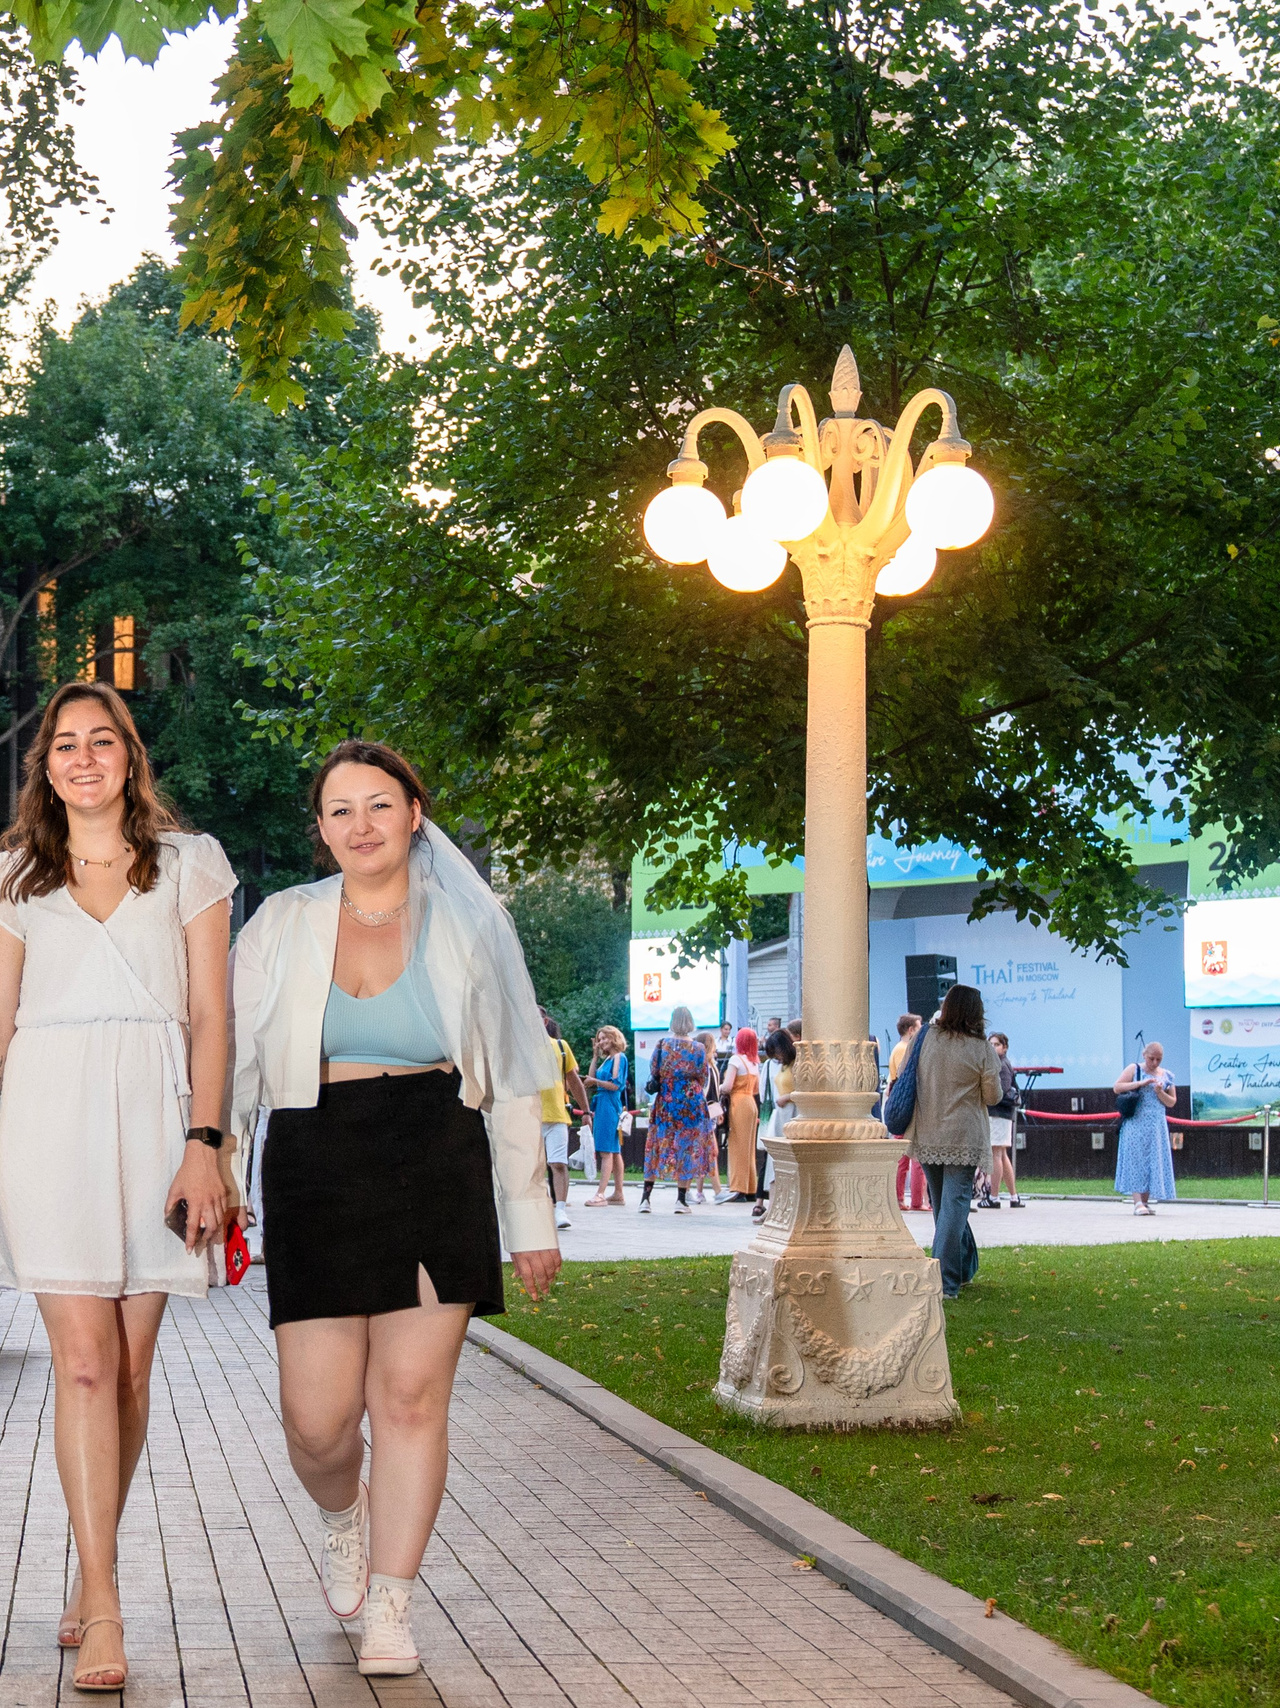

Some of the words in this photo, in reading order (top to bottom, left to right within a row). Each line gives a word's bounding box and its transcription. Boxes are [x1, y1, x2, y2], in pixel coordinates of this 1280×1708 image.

[1017, 962, 1060, 973] FESTIVAL
[1027, 973, 1060, 982] MOSCOW
[1207, 1053, 1247, 1073] Creative
[1220, 1074, 1232, 1089] to
